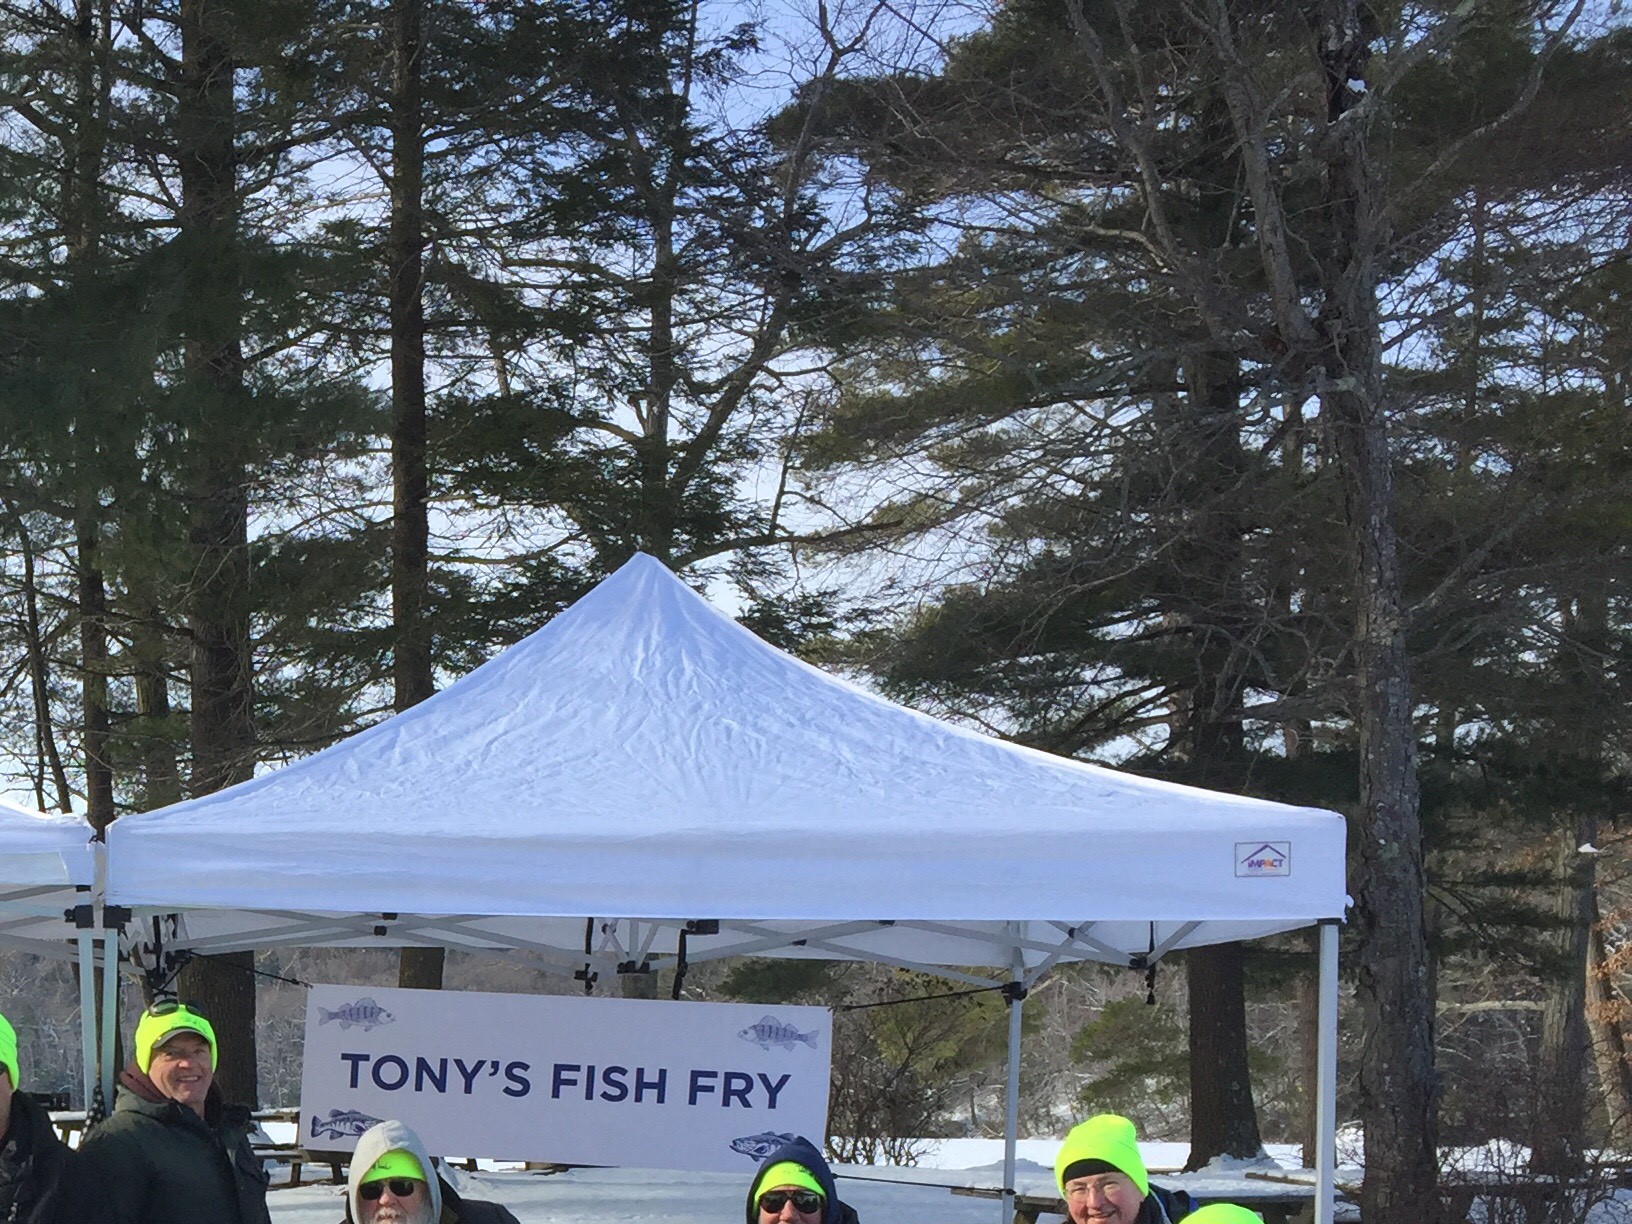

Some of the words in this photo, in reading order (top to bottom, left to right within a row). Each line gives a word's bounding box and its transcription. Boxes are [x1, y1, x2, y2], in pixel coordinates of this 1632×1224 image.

[340, 1052, 531, 1098] TONY'S
[551, 1063, 667, 1104] FISH
[688, 1069, 792, 1109] FRY
